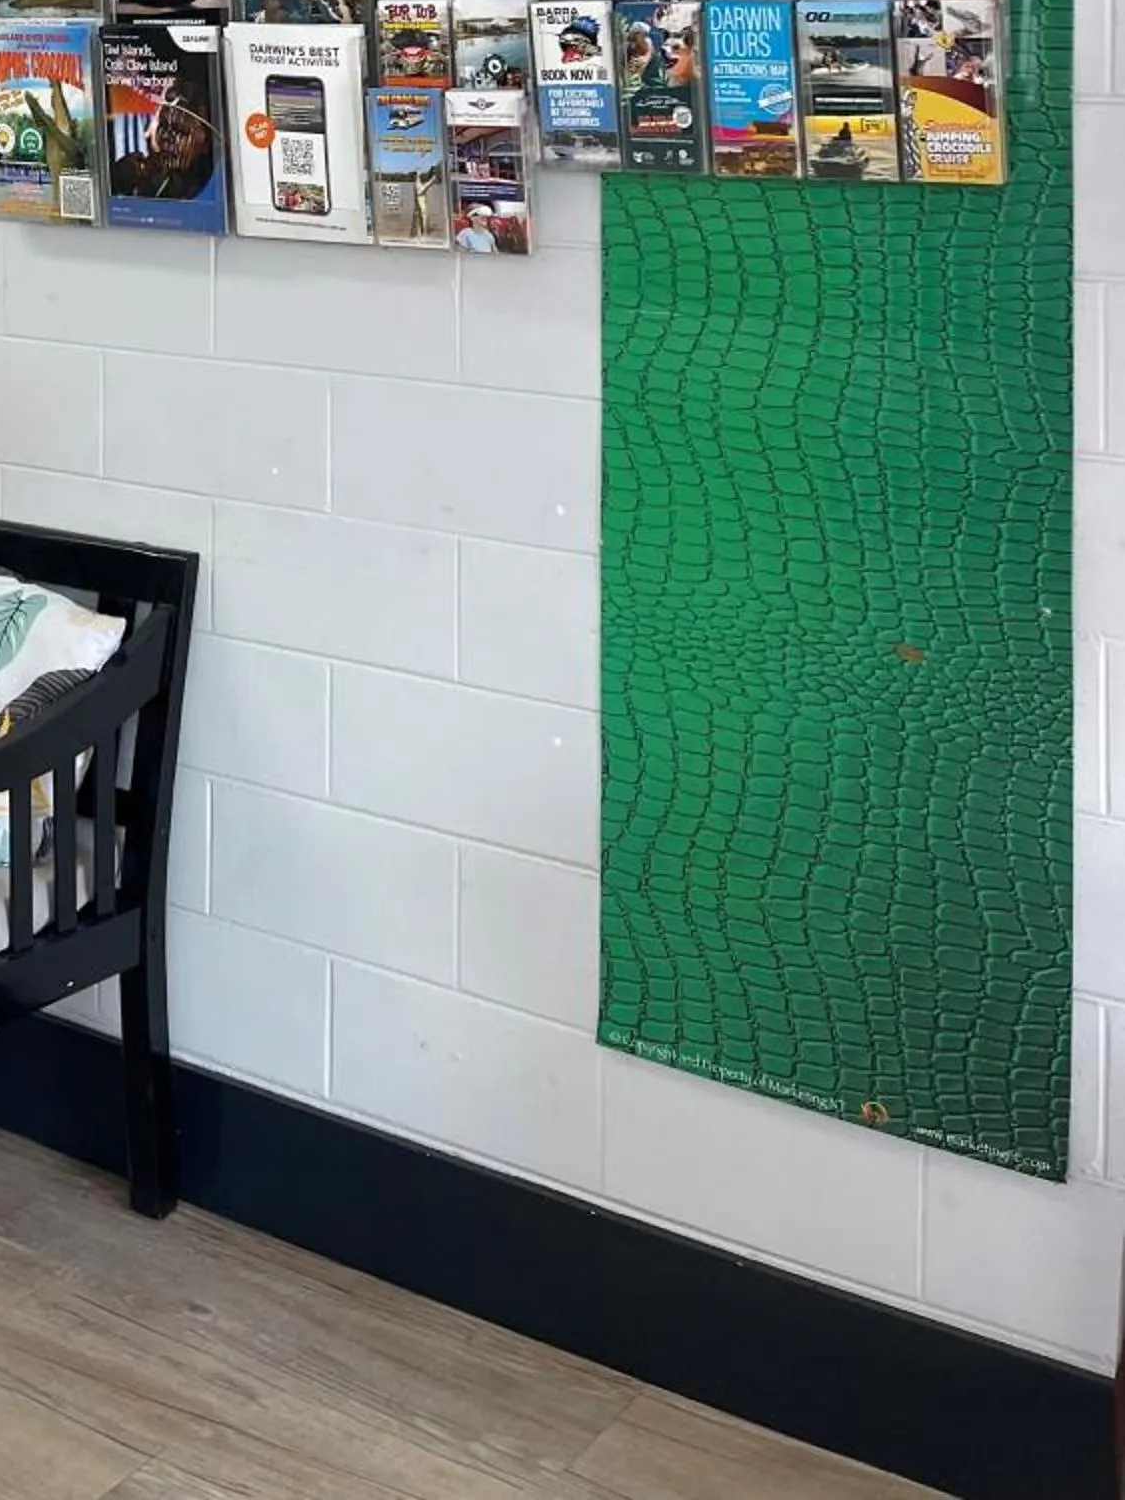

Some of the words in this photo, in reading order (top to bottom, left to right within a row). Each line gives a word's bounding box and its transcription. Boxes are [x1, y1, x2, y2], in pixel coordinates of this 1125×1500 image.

[536, 7, 579, 18] BARRA
[709, 5, 781, 32] DARWIN
[249, 43, 306, 57] DARWIN'S
[308, 45, 340, 58] BEST
[711, 31, 772, 57] TOURS
[148, 58, 178, 71] Island
[250, 54, 286, 65] TOURIST
[287, 56, 340, 67] ACTIVITIES
[541, 69, 568, 81] BOOK
[570, 69, 594, 81] NOW
[713, 63, 768, 76] ATTRACTIONS
[769, 64, 788, 77] MAP
[136, 73, 176, 87] Harbour
[926, 131, 981, 143] JUMPING
[926, 142, 993, 154] CROCODILE
